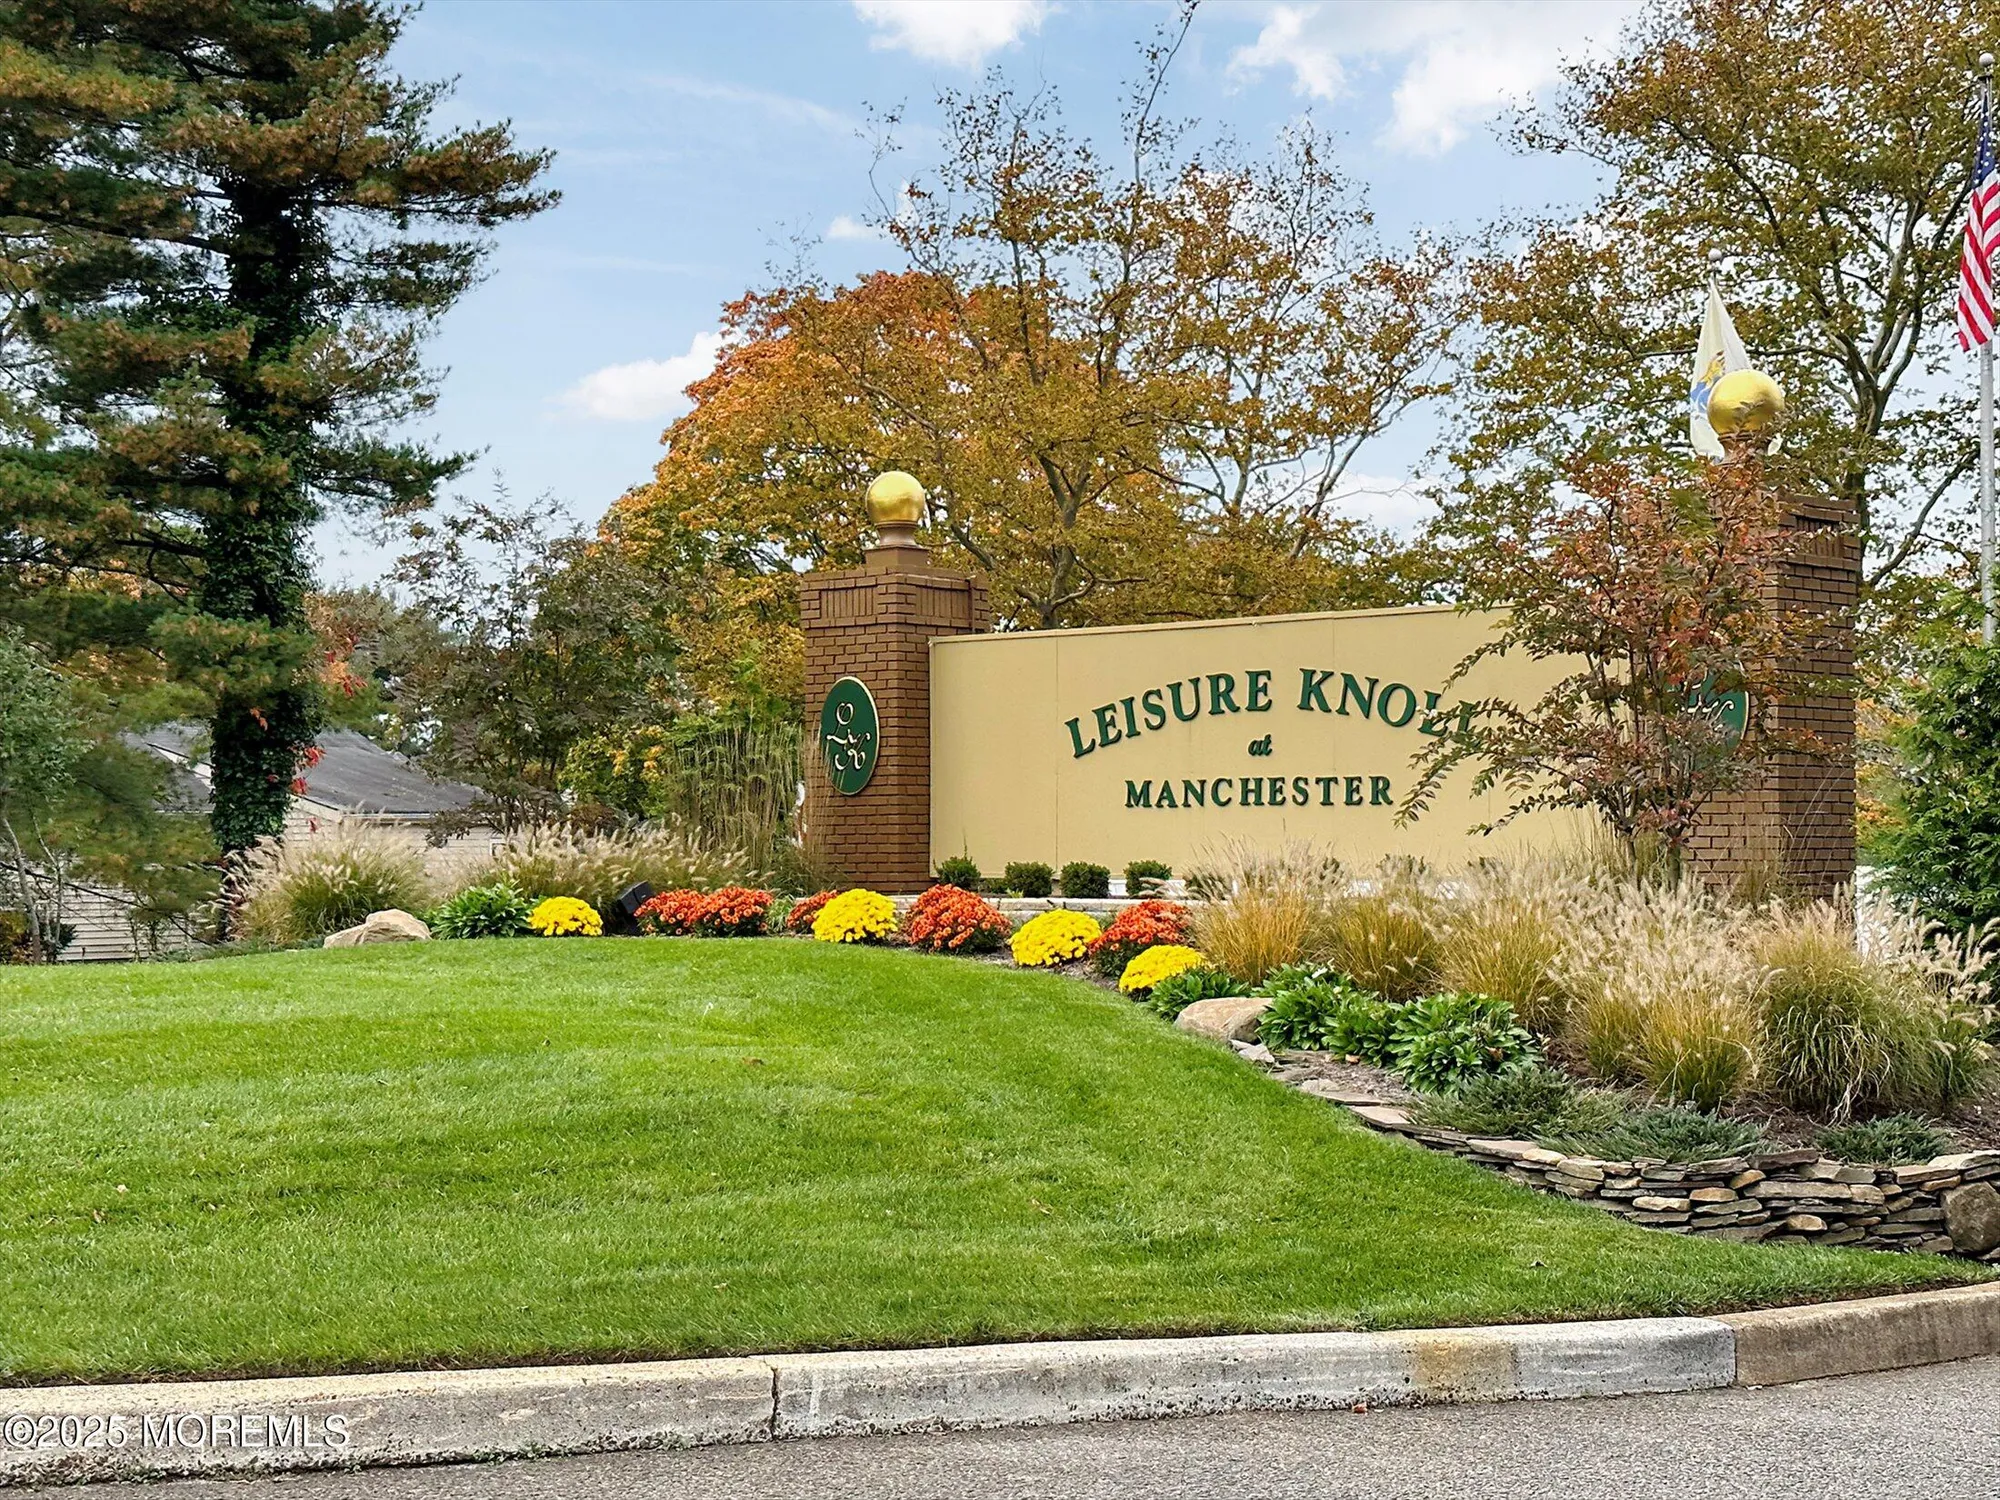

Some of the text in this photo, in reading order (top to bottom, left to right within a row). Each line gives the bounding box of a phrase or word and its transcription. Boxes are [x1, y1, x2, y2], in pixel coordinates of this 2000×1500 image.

[1064, 669, 1273, 759] LEISURE
[1247, 733, 1273, 757] at
[1124, 775, 1394, 809] MANCHESTER
